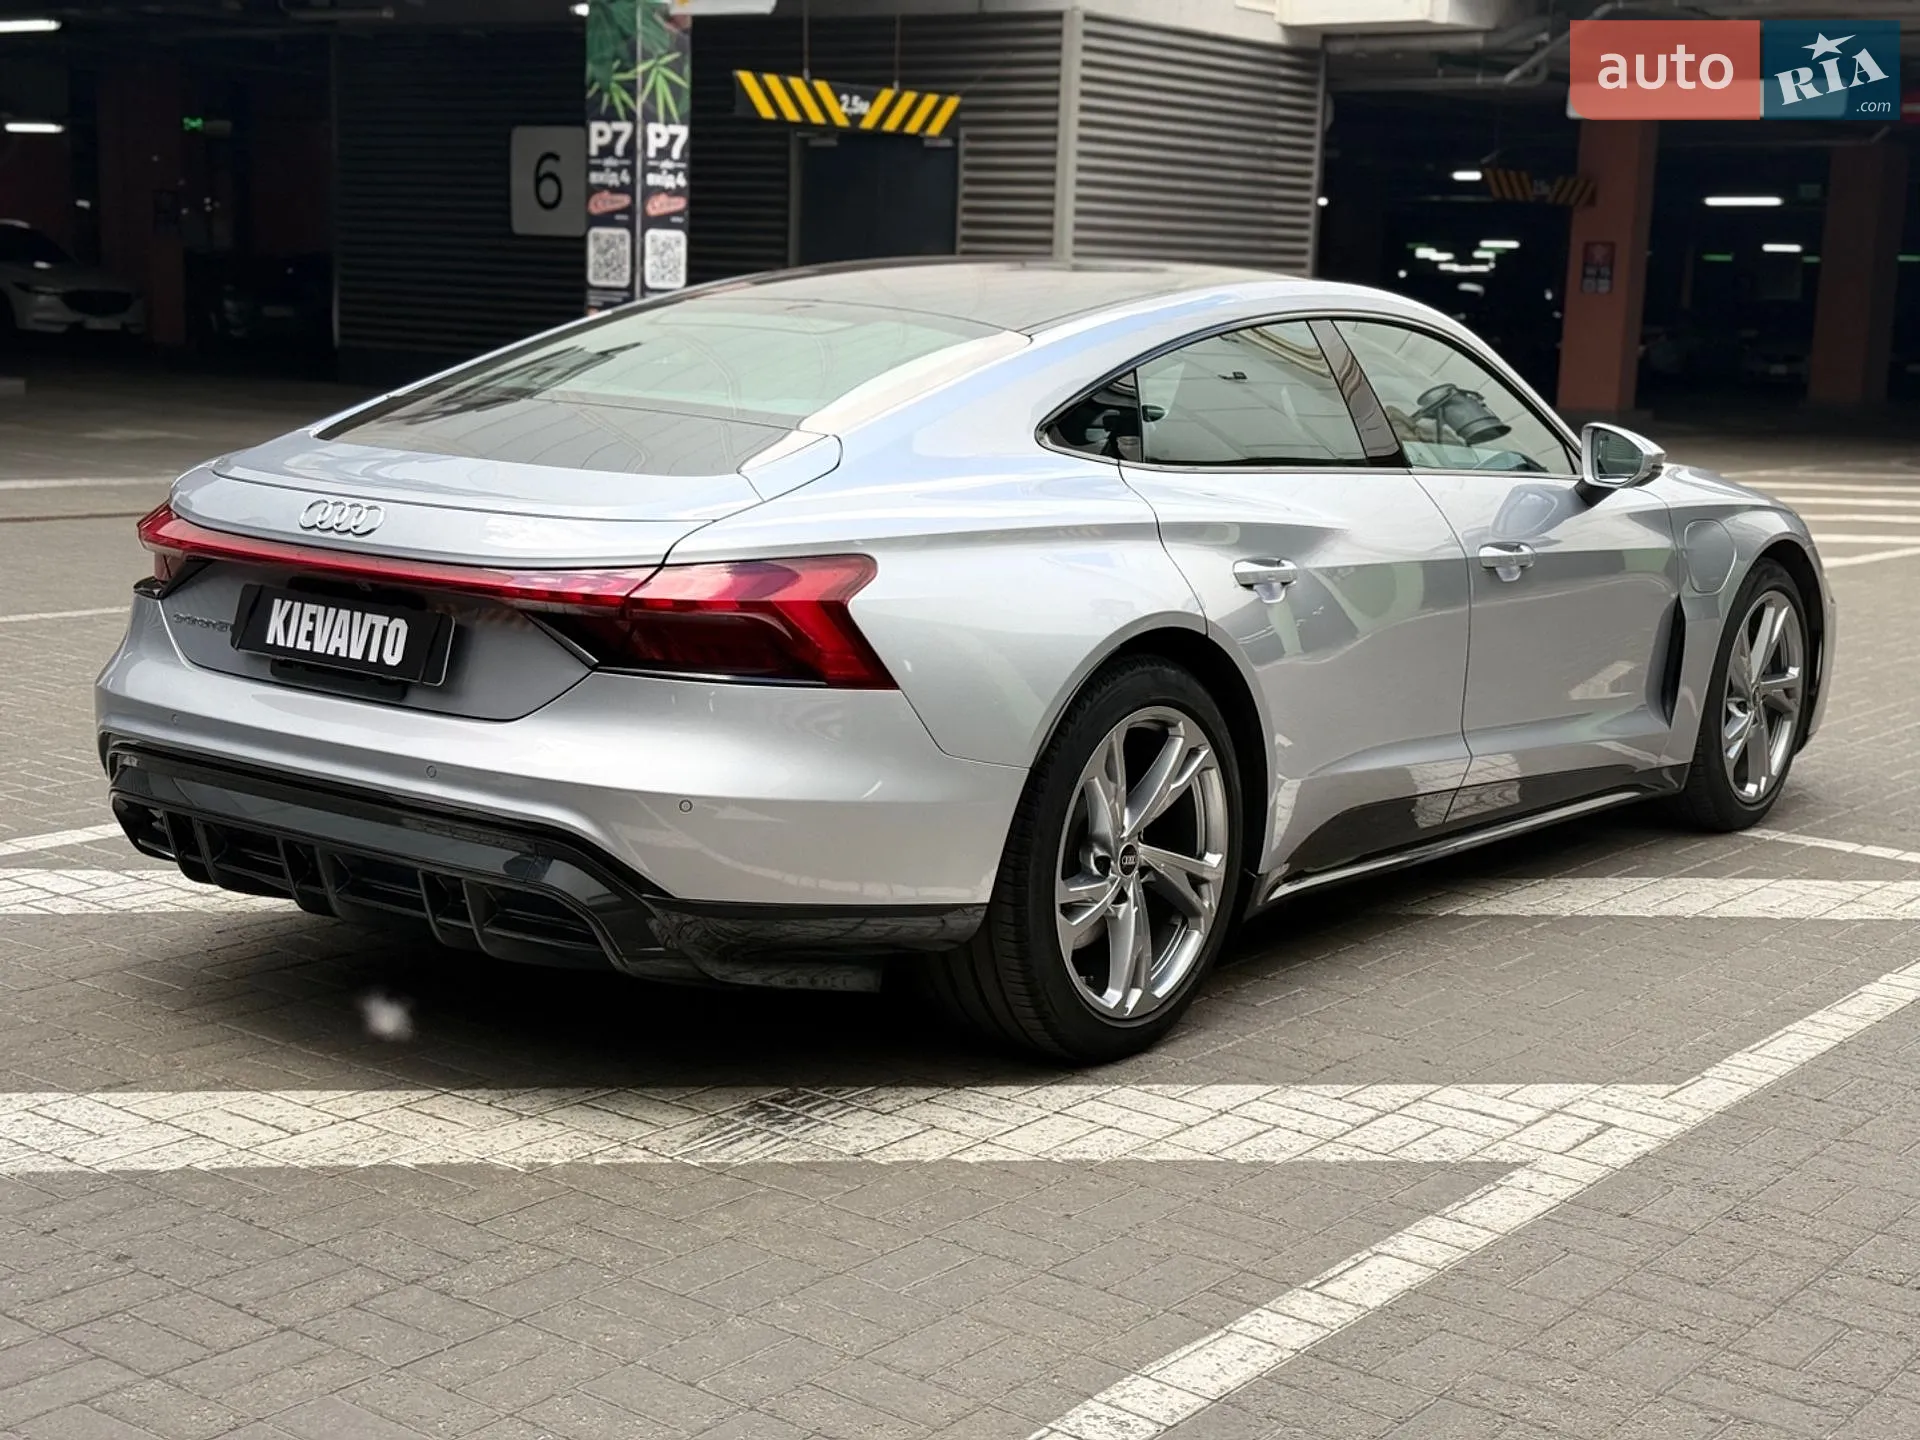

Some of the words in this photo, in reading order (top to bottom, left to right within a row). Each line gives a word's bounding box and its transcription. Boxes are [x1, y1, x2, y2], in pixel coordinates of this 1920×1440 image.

[589, 121, 634, 157] P7
[647, 122, 689, 160] P7
[535, 151, 562, 210] 6
[265, 598, 409, 667] KIEVAVTO
